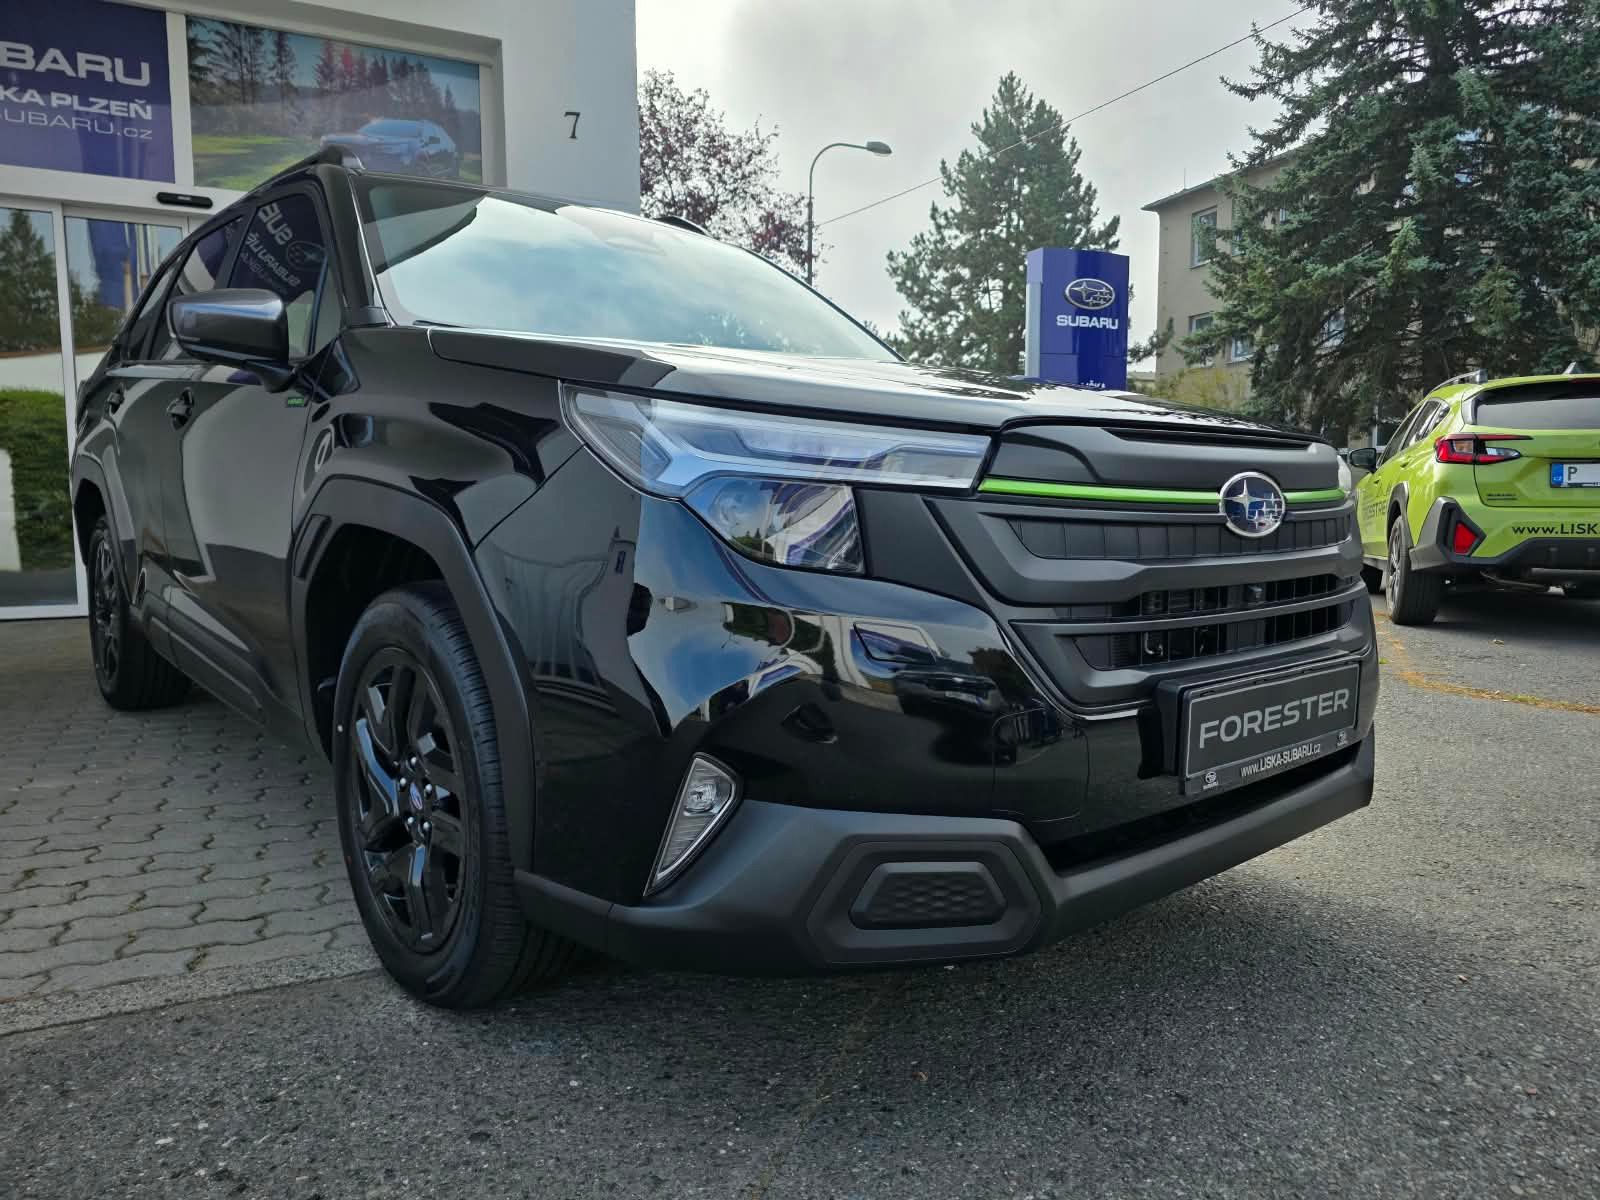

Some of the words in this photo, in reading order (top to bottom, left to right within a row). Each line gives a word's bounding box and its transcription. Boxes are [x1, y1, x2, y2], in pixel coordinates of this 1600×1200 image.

[50, 91, 152, 120] PLZEŇ
[0, 108, 153, 139] UBARU.cz
[564, 111, 580, 140] 7
[1056, 314, 1119, 329] SUBARU
[1512, 523, 1600, 535] www.LISK
[1199, 688, 1349, 749] FORESTER
